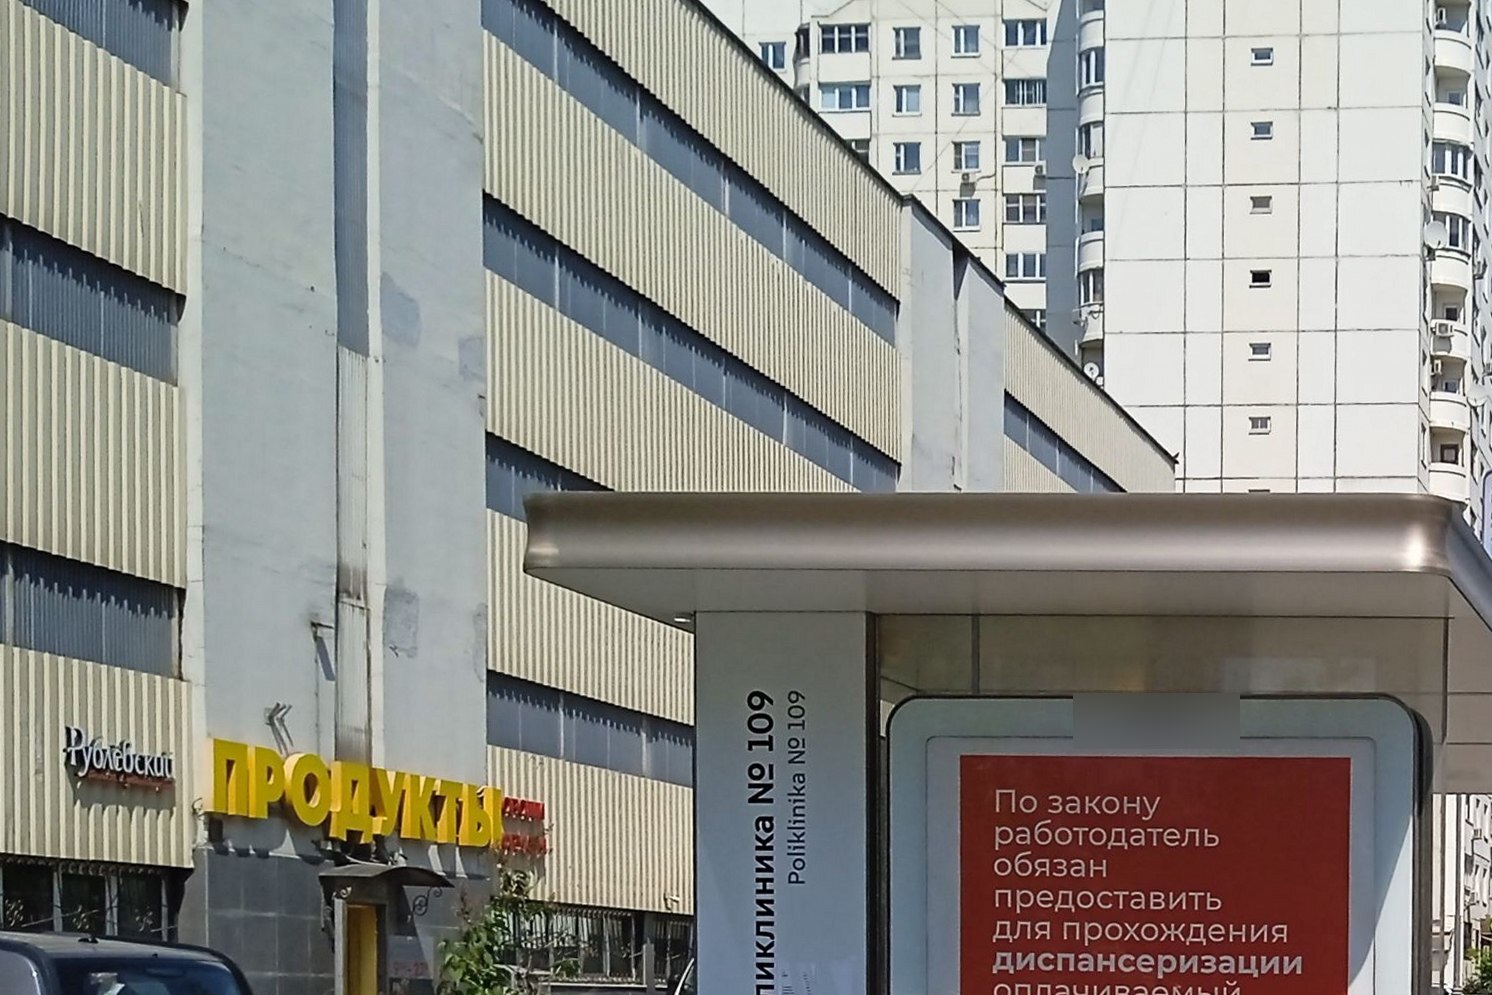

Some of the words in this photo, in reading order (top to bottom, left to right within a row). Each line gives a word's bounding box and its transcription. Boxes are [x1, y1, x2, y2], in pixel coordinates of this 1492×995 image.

[747, 690, 775, 752] 109
[787, 690, 806, 730] 109
[787, 735, 806, 764] №
[211, 738, 503, 847] ПРОДУКТЫ
[747, 762, 775, 804] №
[995, 789, 1038, 814] По
[1047, 795, 1161, 820] закону
[787, 773, 806, 885] Poliklinika
[995, 819, 1220, 850] работодатель
[993, 851, 1107, 877] обязан
[994, 888, 1222, 913] предоставить
[992, 919, 1051, 943] для
[1062, 920, 1289, 946] прохождения
[992, 951, 1303, 979] диспансеризации
